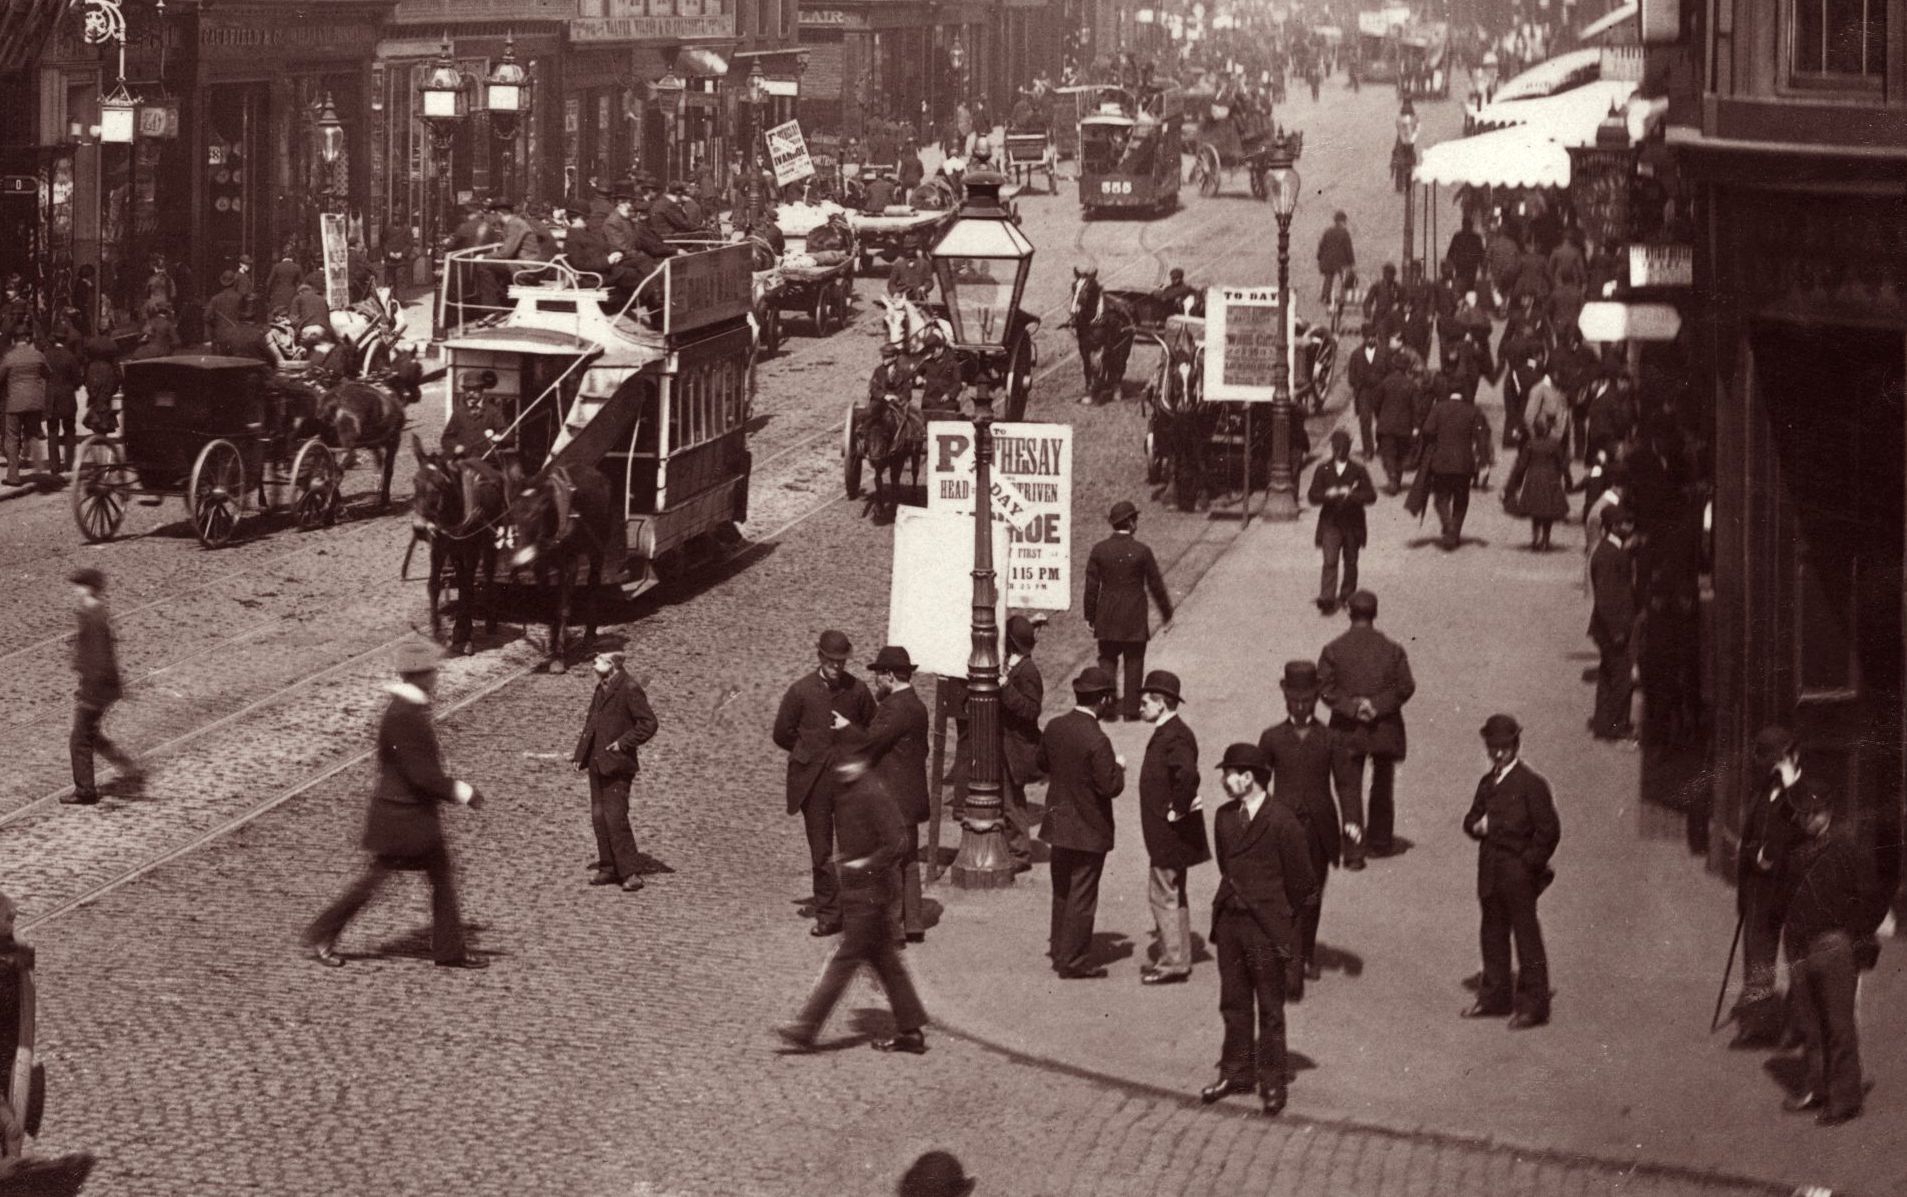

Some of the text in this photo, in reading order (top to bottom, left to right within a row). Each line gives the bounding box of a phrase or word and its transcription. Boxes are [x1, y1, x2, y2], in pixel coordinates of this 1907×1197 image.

[1224, 291, 1279, 301] TO DAY
[940, 480, 969, 499] HEAD
[1018, 548, 1042, 559] FIRST
[1039, 567, 1061, 581] PM
